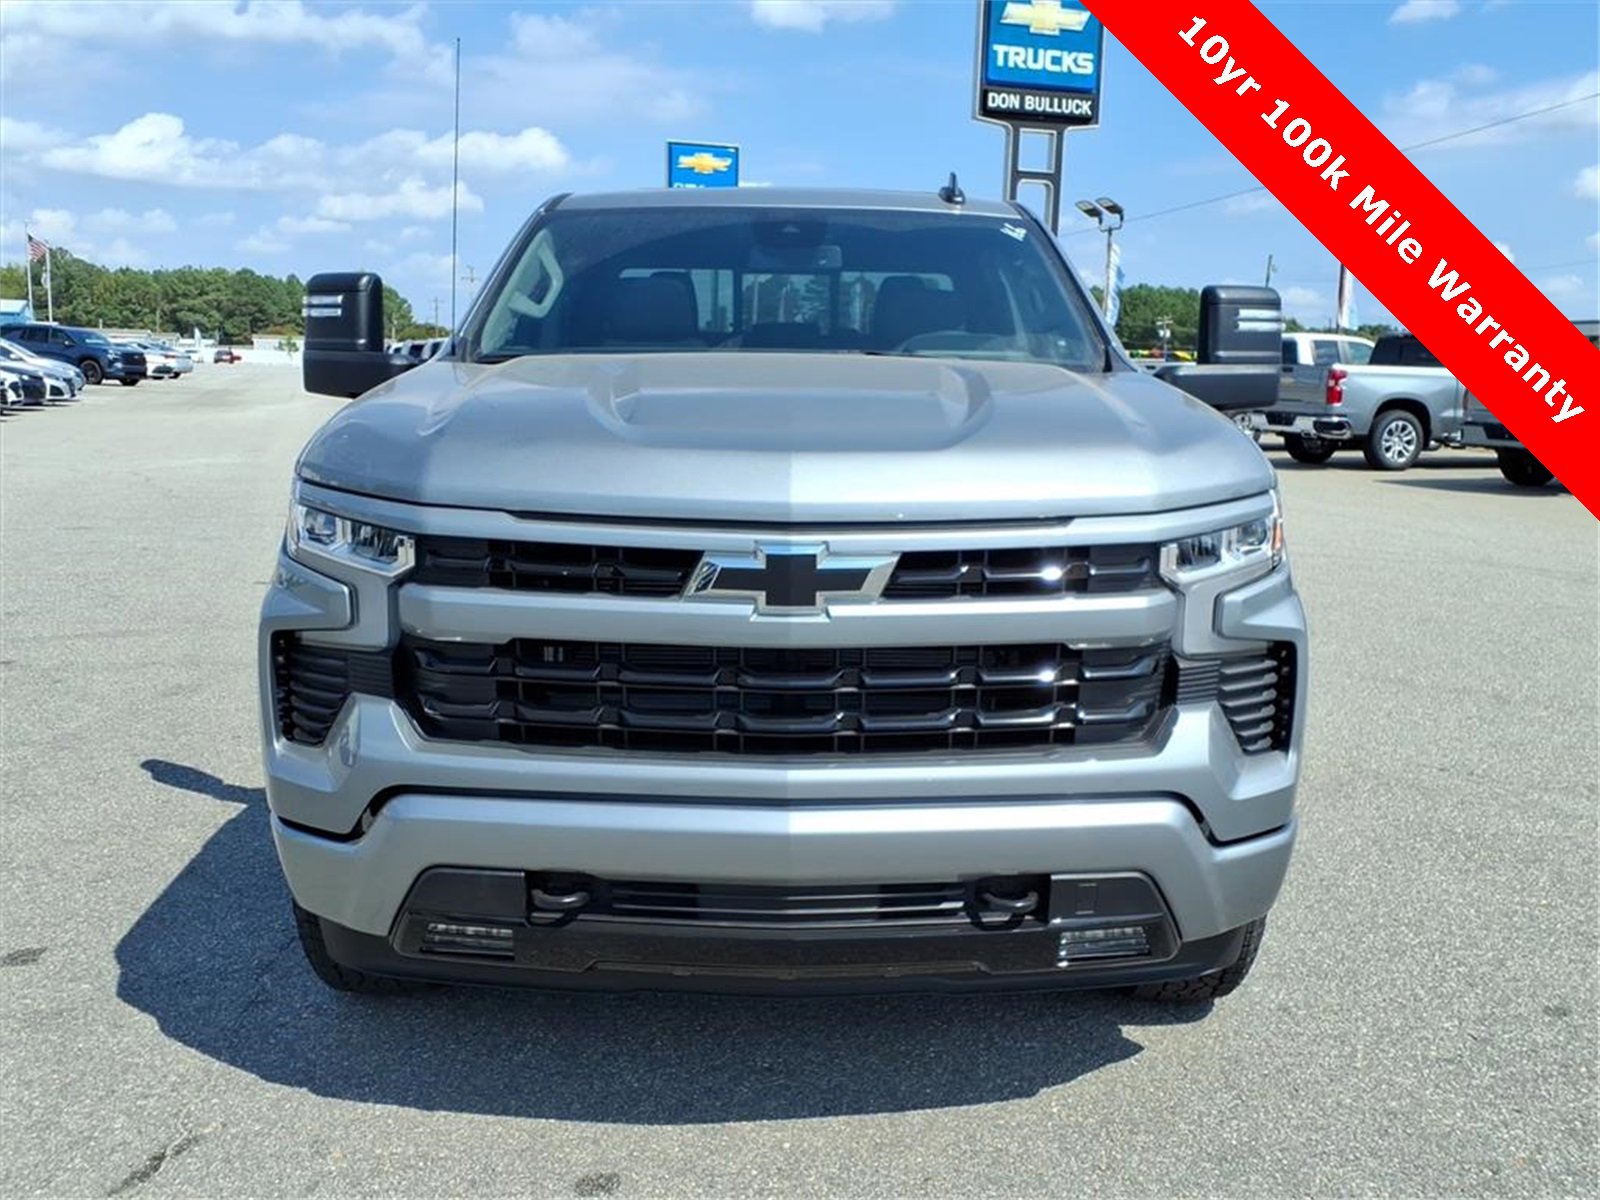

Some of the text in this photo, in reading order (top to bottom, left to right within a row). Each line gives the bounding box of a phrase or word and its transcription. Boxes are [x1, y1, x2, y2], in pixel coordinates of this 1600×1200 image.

[992, 44, 1094, 75] TRUCKS
[987, 91, 1093, 116] DON BULLUCK
